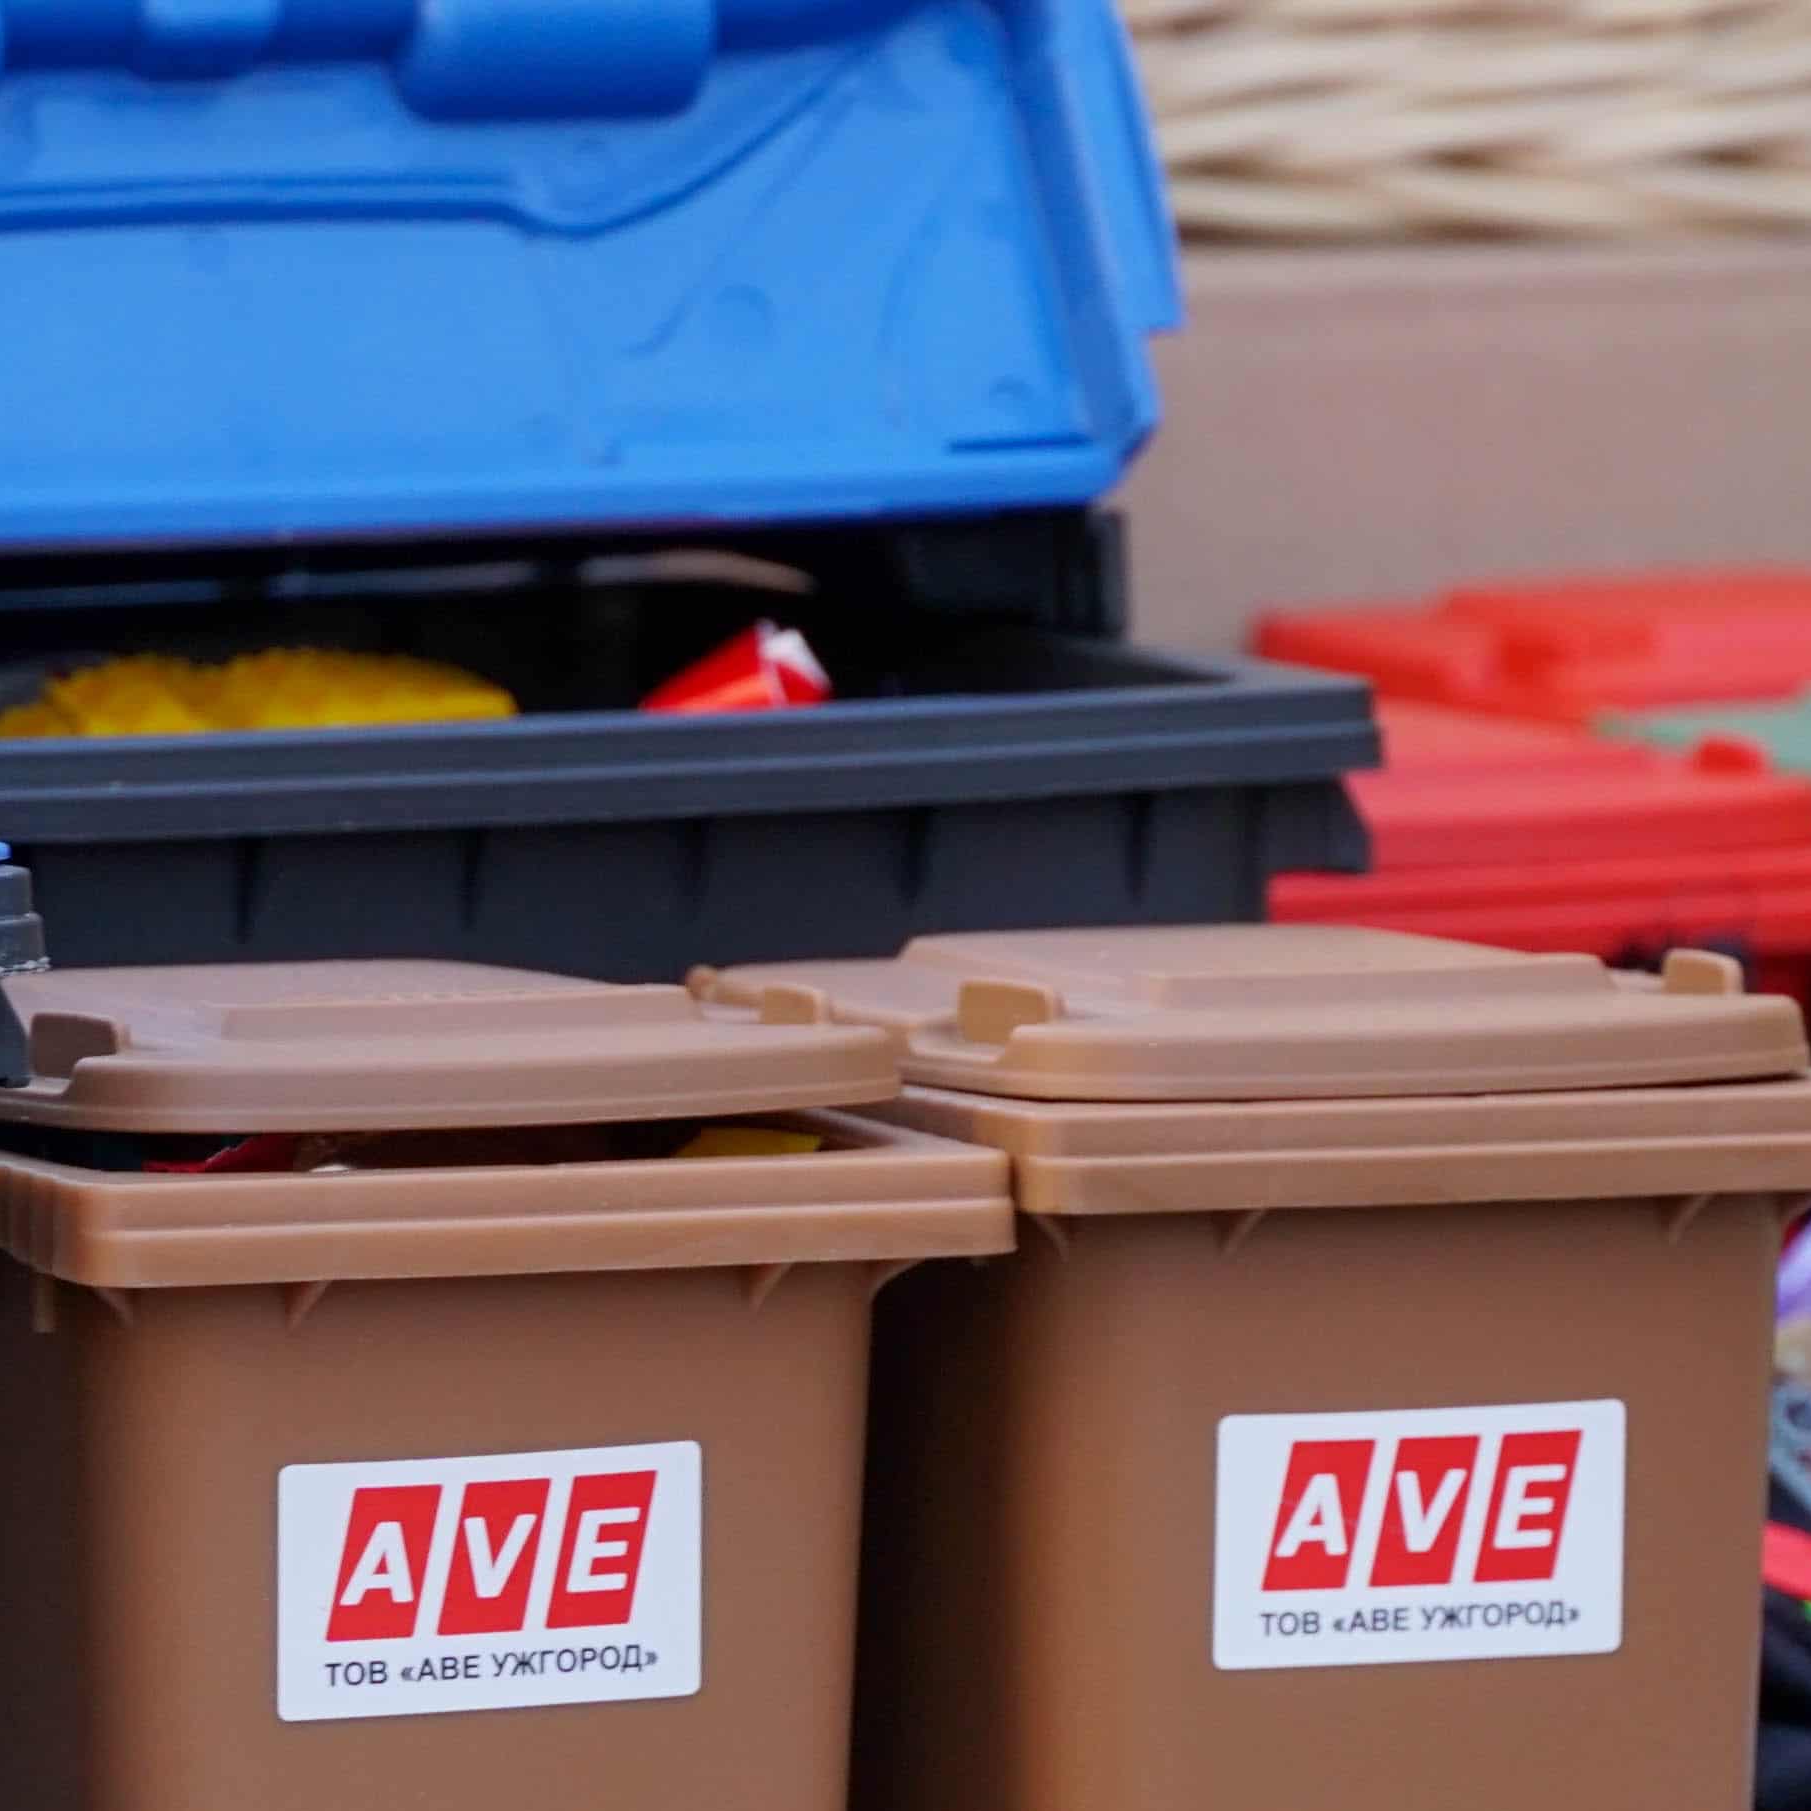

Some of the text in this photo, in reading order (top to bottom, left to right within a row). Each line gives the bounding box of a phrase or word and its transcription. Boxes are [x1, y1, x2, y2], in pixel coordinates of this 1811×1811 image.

[1271, 1460, 1571, 1561] AVE
[336, 1503, 644, 1609] AVE
[1259, 1600, 1581, 1638] ТОВ «АВЕ УЖГОРОД»
[324, 1643, 660, 1688] ТОВ «АВЕ УЖГОРОД»
